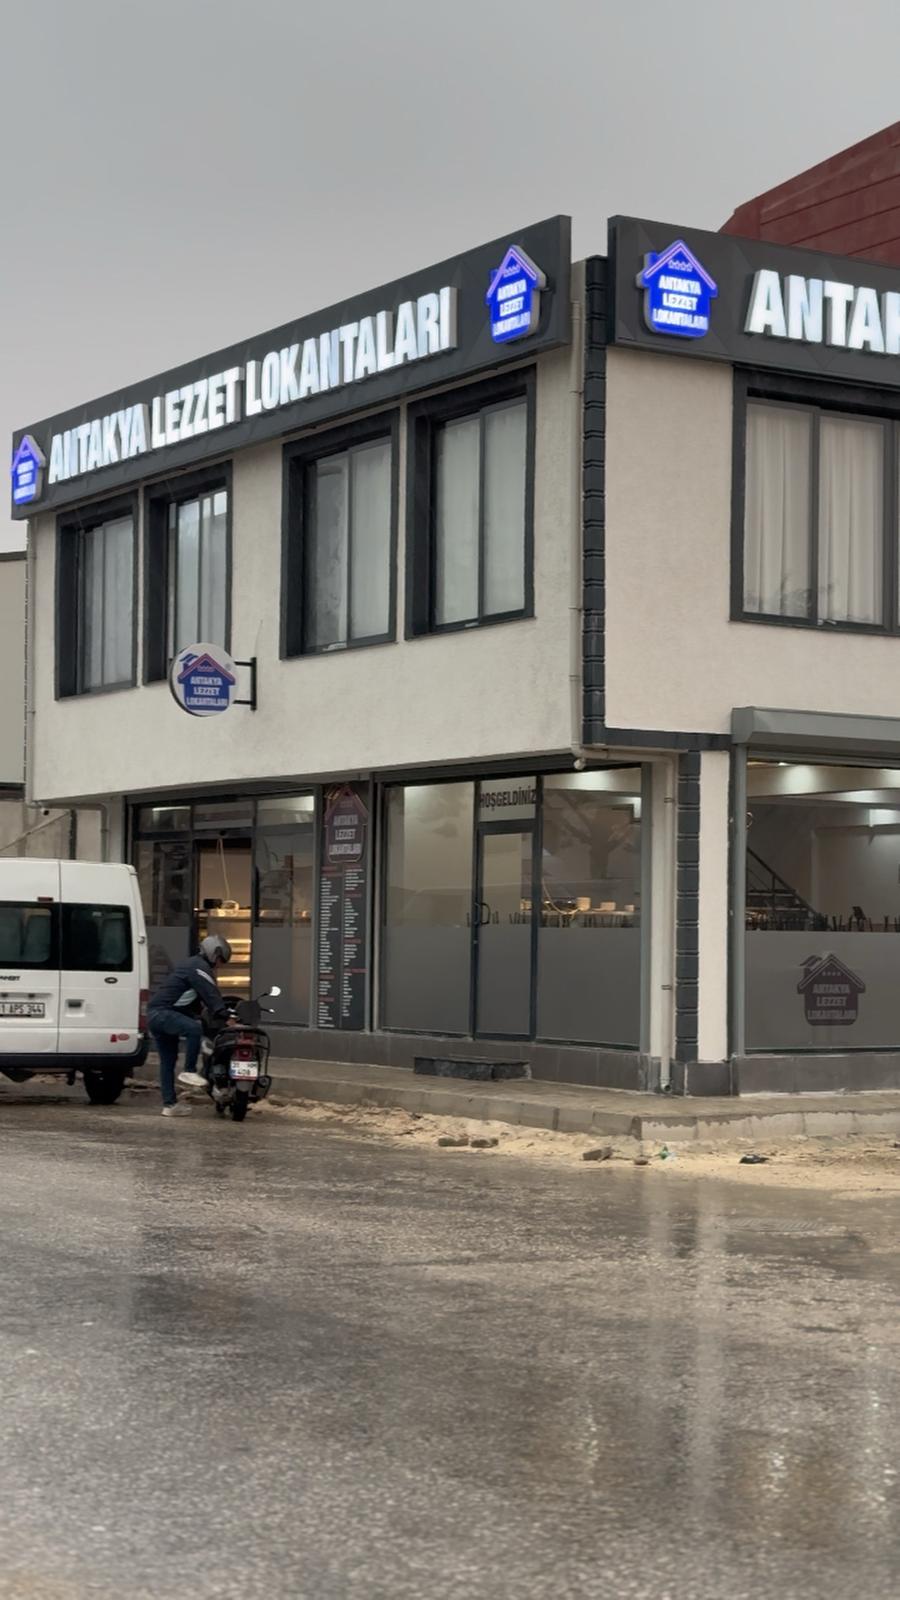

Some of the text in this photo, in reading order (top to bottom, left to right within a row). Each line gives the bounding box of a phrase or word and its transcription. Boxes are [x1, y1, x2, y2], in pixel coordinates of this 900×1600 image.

[659, 275, 701, 295] ANTAKYA
[663, 292, 697, 311] LEZZET
[653, 308, 708, 330] LOKANTALARI
[48, 286, 457, 484] ANTAKYA LEZZET LOKANTALARI
[190, 676, 222, 686] ANTAKYA
[193, 687, 220, 696] LEZZET
[817, 997, 847, 1007] LEZZET
